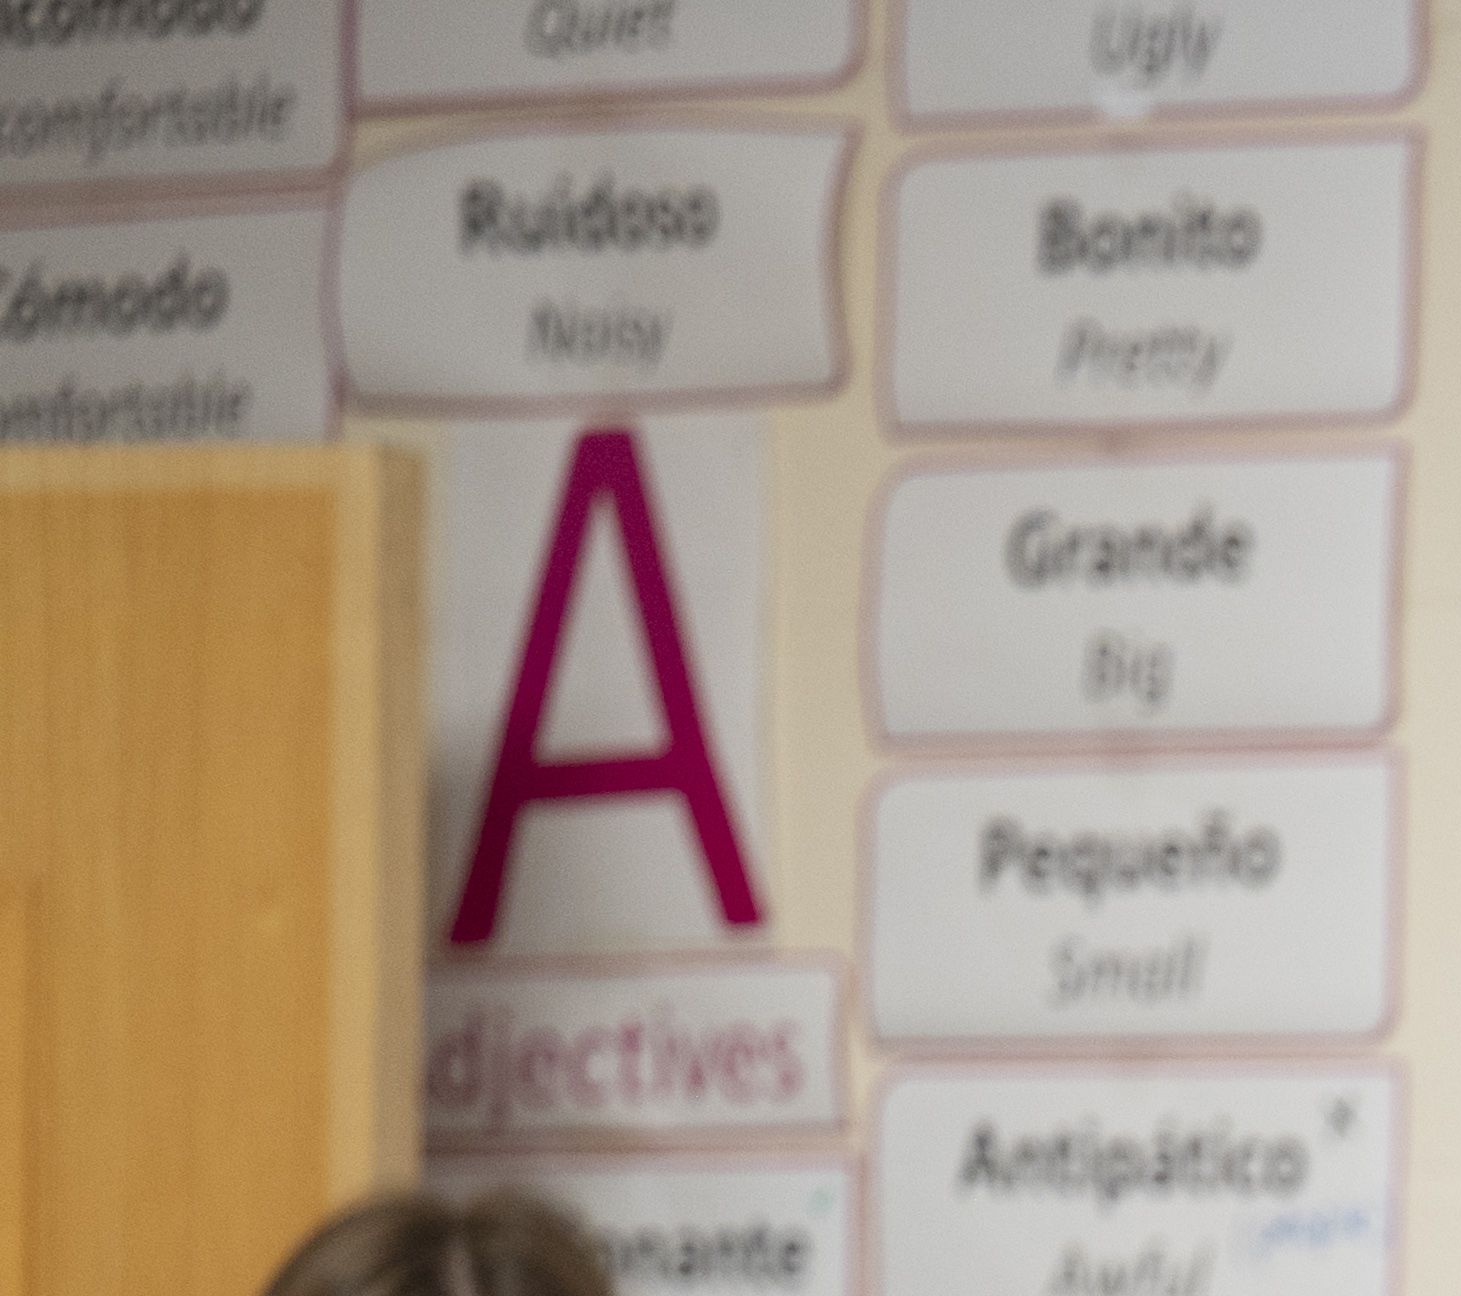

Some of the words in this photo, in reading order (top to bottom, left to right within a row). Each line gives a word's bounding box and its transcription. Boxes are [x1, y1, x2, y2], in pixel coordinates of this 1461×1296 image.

[458, 172, 722, 256] Ruidoso
[1038, 192, 1264, 274] Bonito
[1005, 505, 1254, 588] Grande
[446, 425, 770, 945] A
[975, 808, 1285, 908] Pequeño
